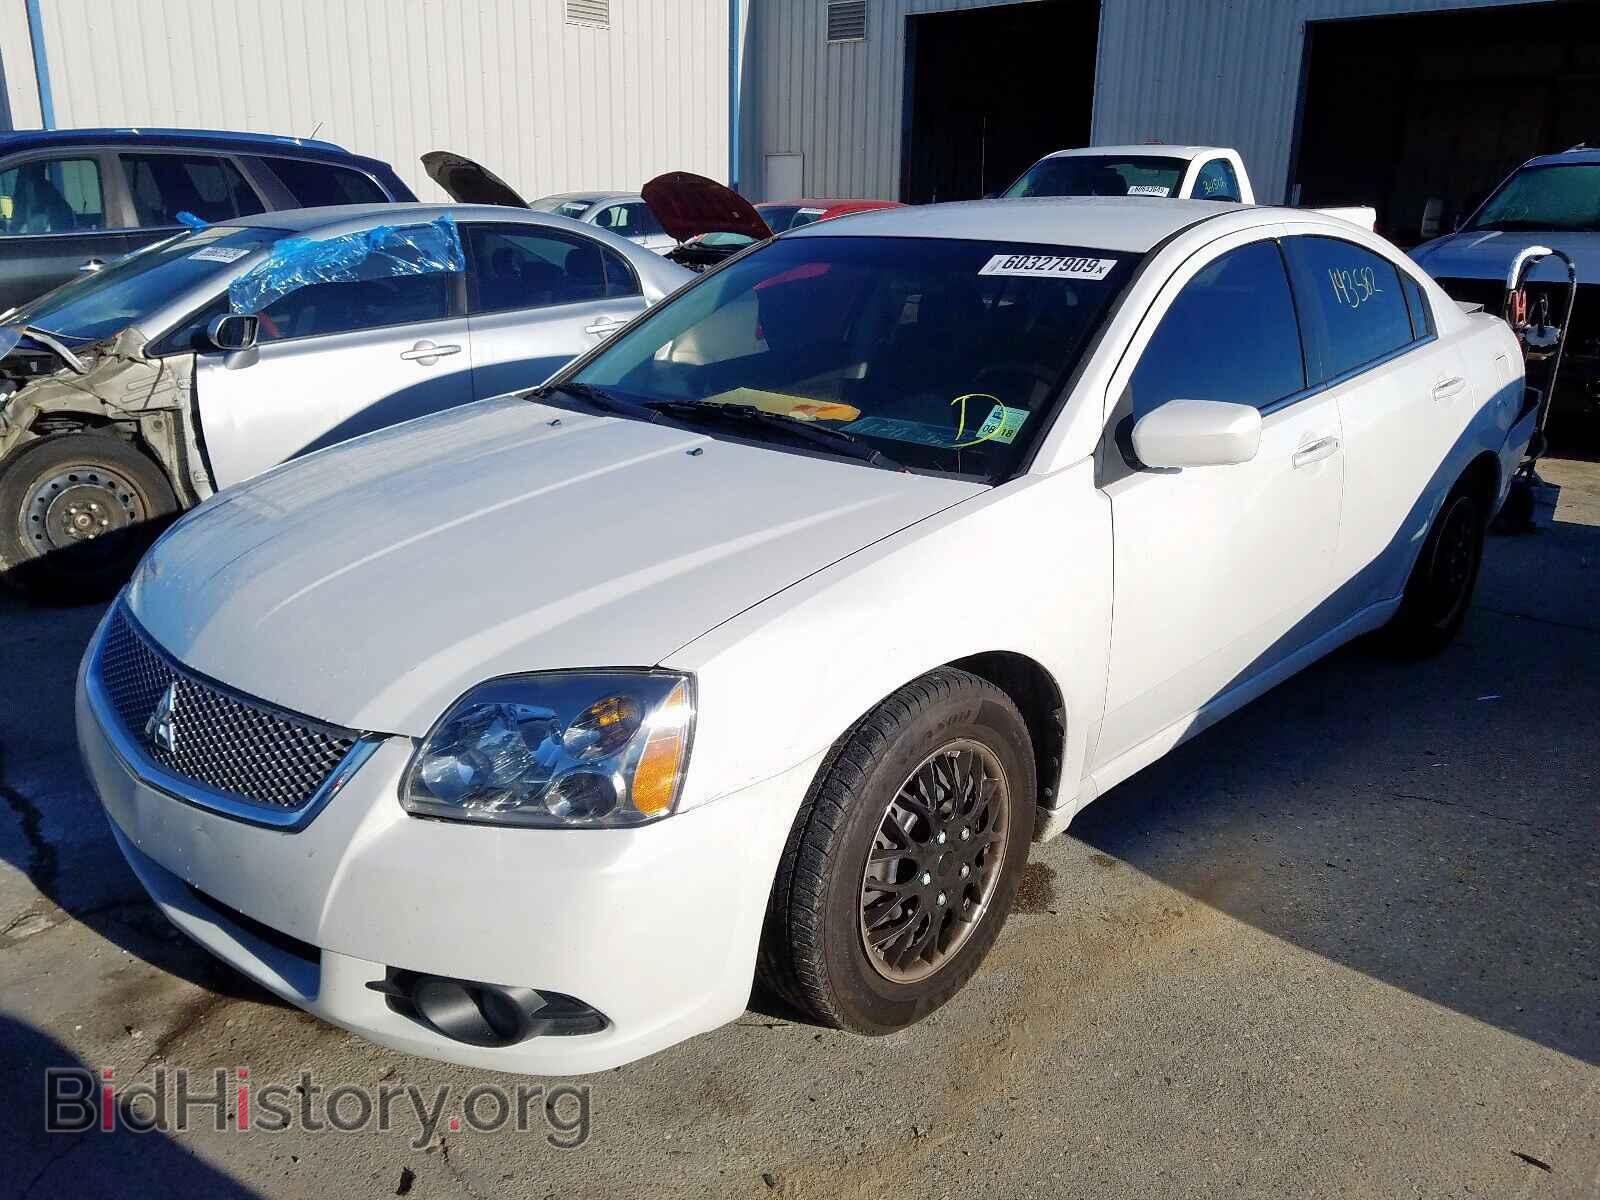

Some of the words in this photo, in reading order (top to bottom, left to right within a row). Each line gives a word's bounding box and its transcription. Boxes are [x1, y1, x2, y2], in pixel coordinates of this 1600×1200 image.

[1001, 255, 1101, 273] 60327909
[1328, 266, 1385, 309] 143582
[1000, 428, 1014, 438] 18
